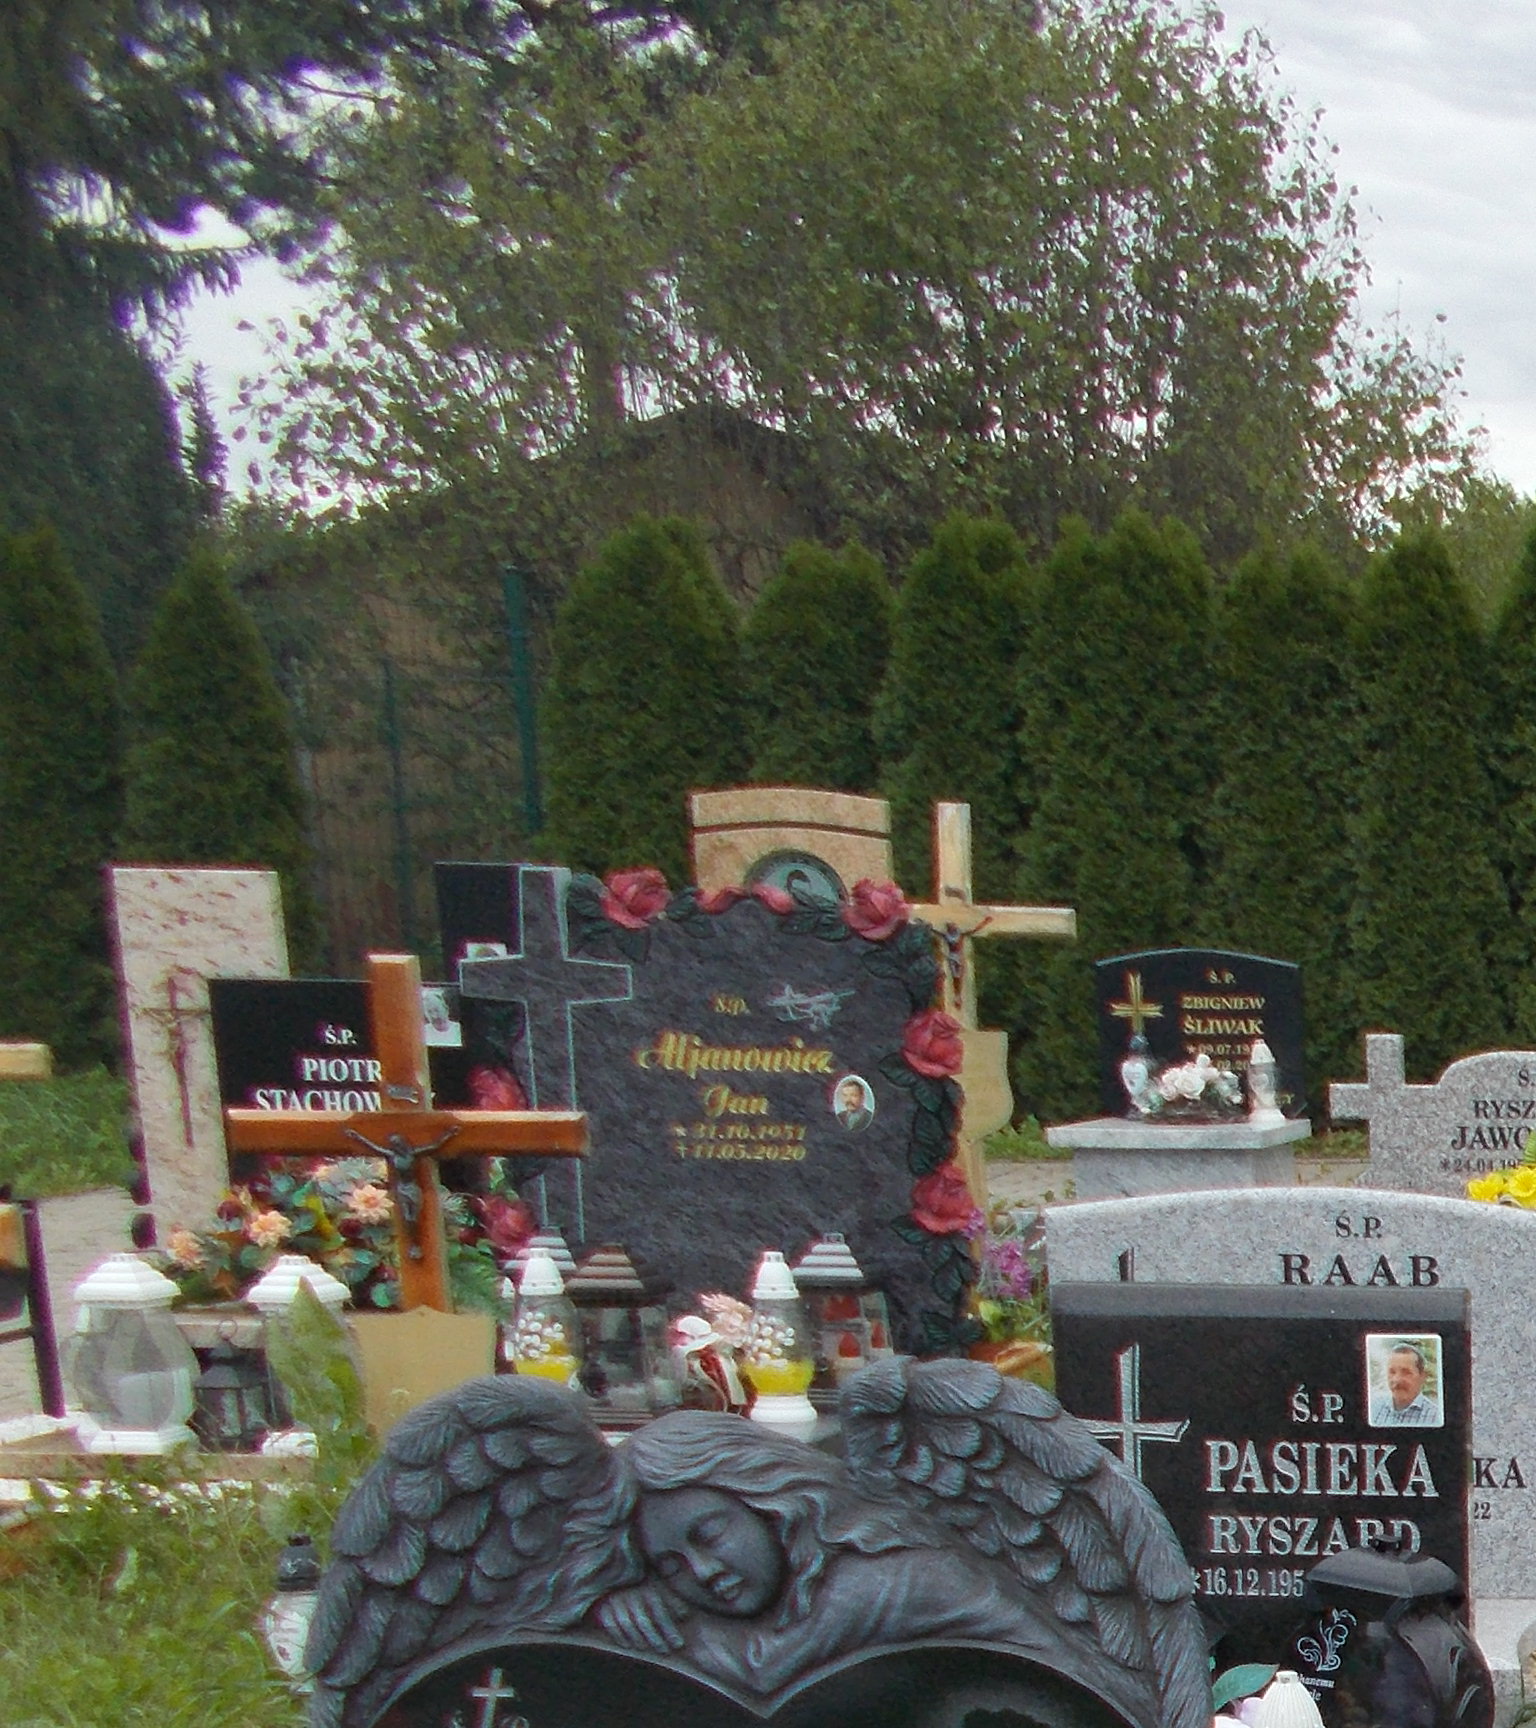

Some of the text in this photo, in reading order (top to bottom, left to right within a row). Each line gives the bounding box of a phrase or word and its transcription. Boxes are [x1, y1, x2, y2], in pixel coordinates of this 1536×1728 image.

[1182, 997, 1265, 1010] ZBIGNIEW
[325, 1024, 358, 1045] Ś.P.
[1184, 1014, 1264, 1034] ŚLIWAK
[303, 1058, 382, 1082] PIOTR
[704, 1085, 769, 1118] Jan
[1336, 1210, 1382, 1238] Ś.P.
[1278, 1253, 1440, 1287] RAAB
[1292, 1383, 1345, 1423] Ś.P.
[1205, 1439, 1440, 1497] PASIEKA
[1208, 1514, 1421, 1556] RYSZARD
[1203, 1567, 1305, 1598] 16.12.195
